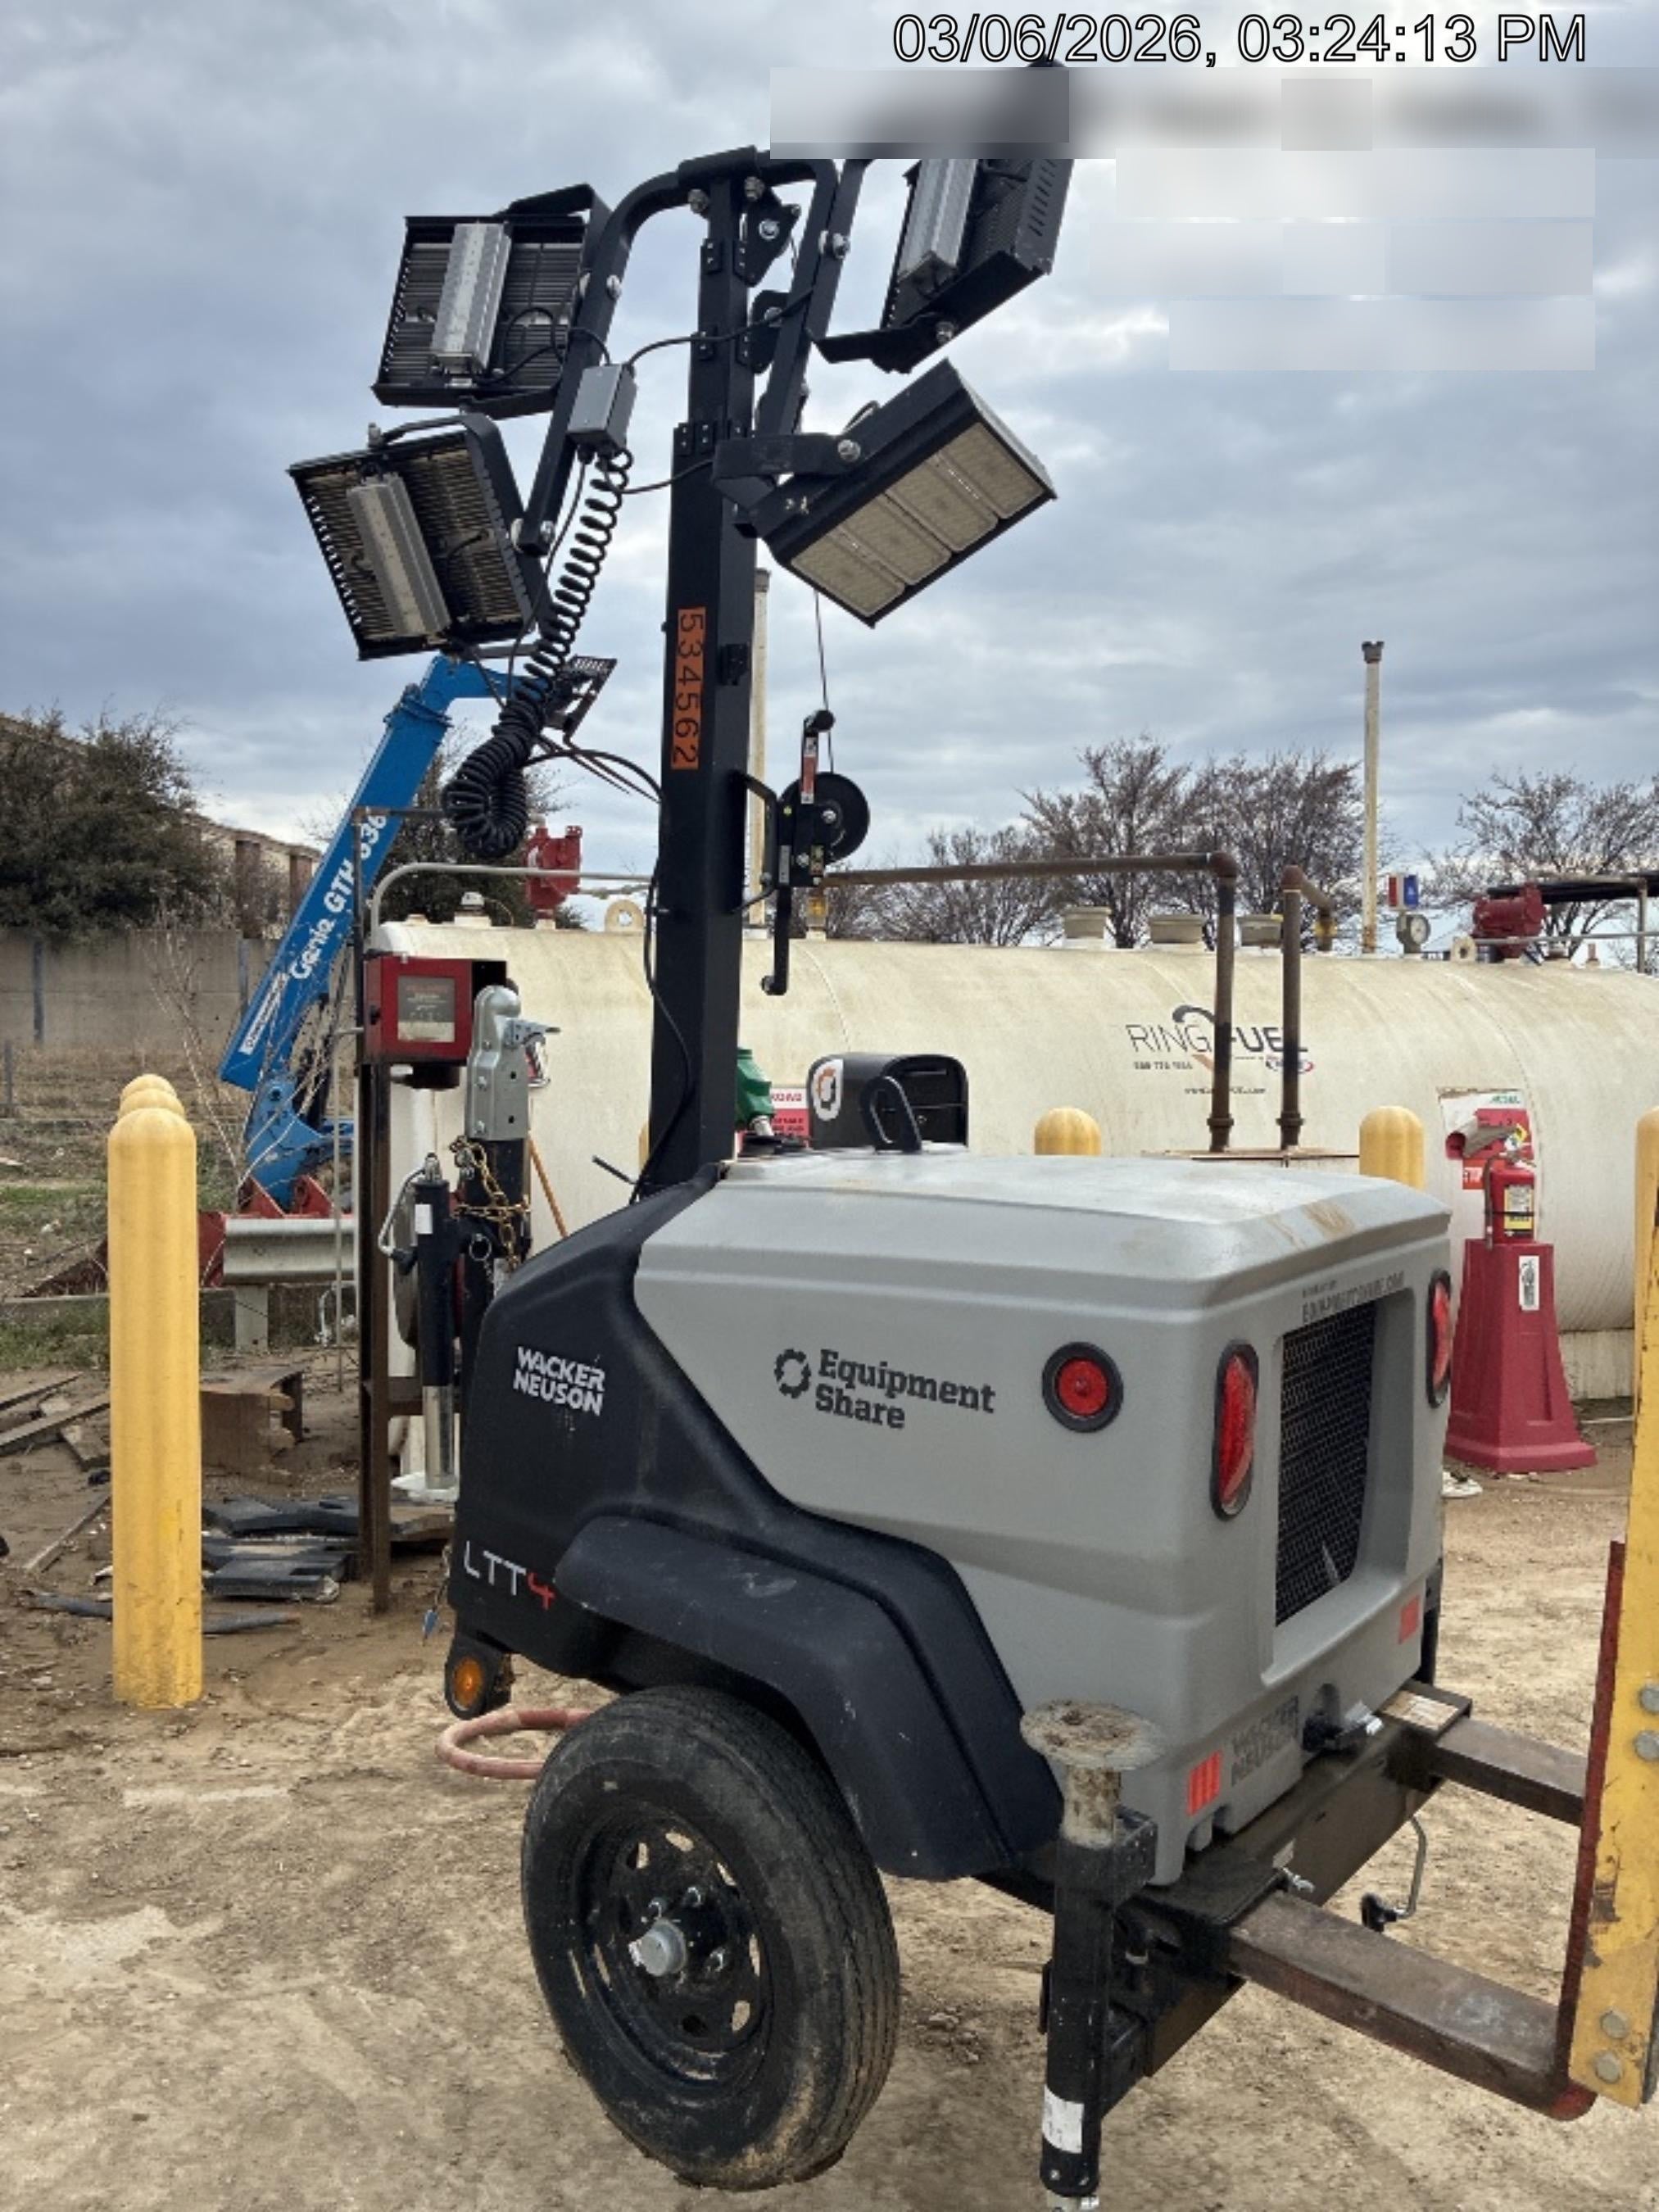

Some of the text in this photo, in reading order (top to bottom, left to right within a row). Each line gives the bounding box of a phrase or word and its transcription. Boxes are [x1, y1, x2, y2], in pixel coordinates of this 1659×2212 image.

[673, 612, 705, 764] 534562
[289, 917, 336, 980] Genie
[1125, 1024, 1213, 1053] RING
[513, 1368, 604, 1417] NEUSON
[516, 1345, 605, 1393] WACKER
[818, 1349, 997, 1414] Equipment
[815, 1383, 905, 1430] Share
[464, 1539, 555, 1611] LTT4
